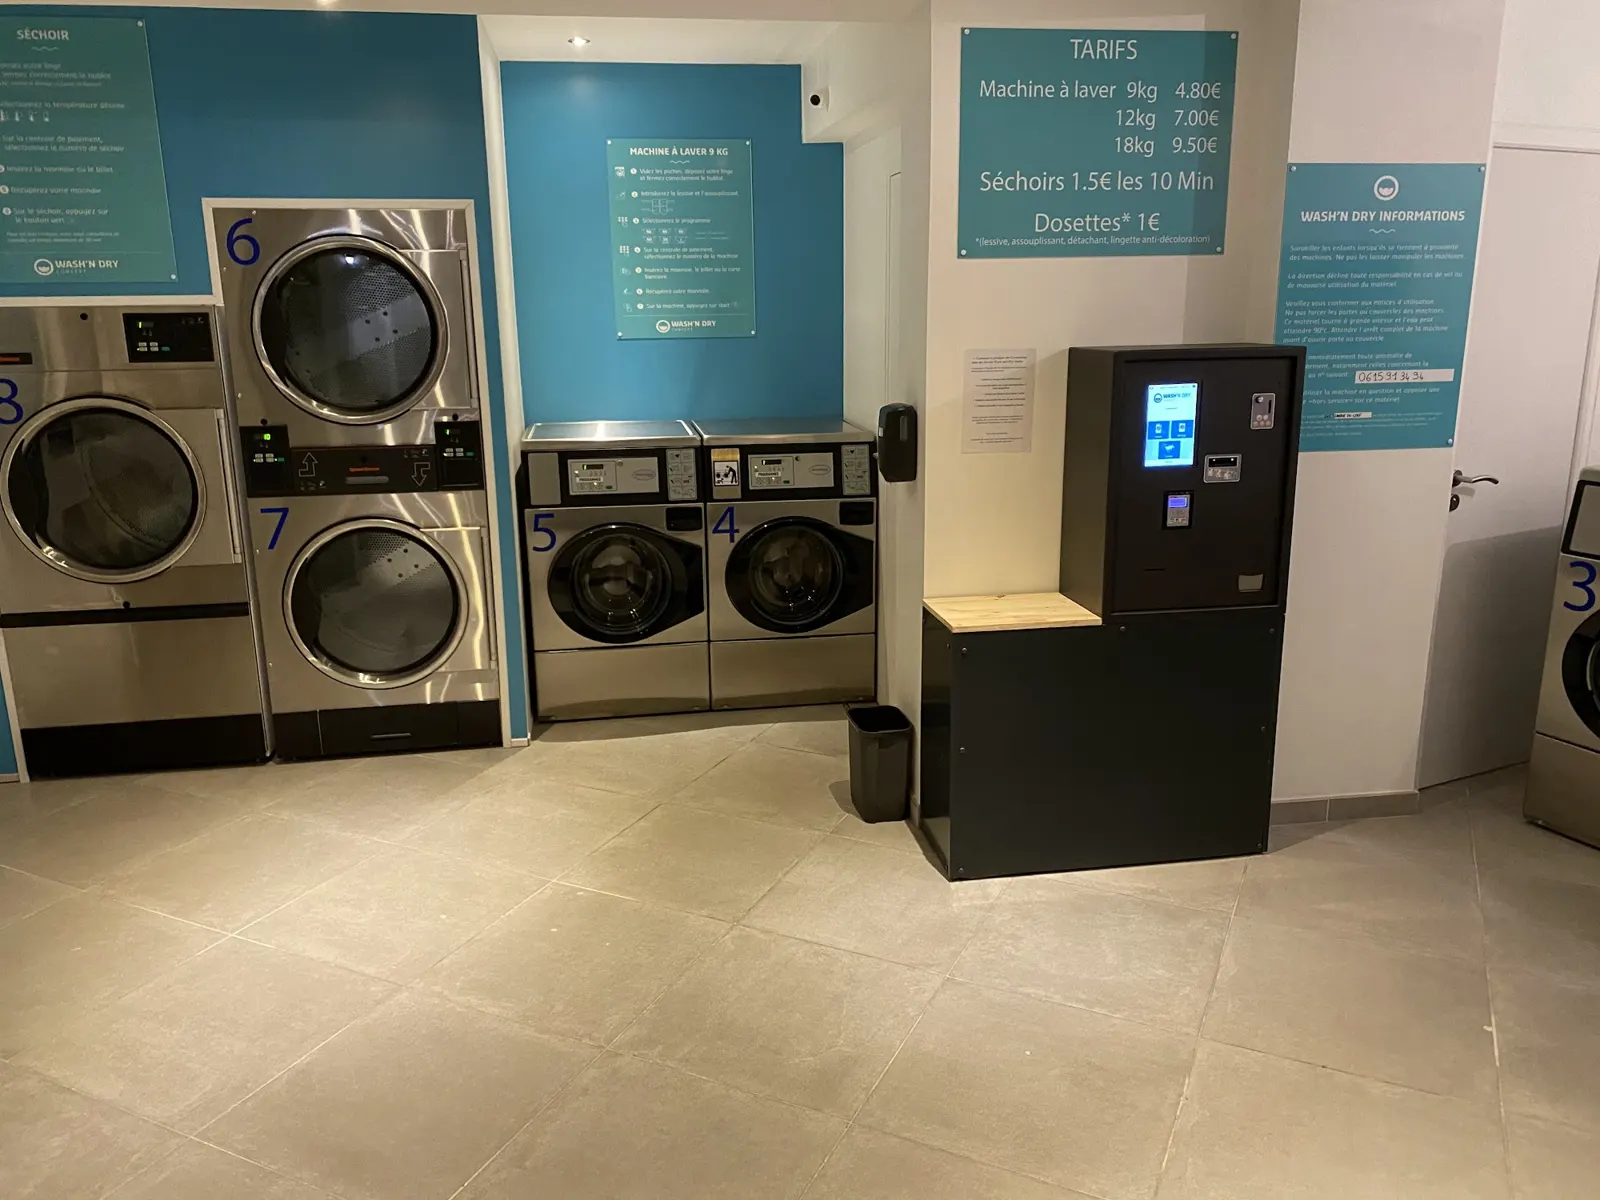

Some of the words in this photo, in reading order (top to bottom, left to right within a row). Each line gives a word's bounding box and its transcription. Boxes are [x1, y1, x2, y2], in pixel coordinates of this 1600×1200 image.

[16, 27, 70, 41] SÉCHOIR
[1070, 39, 1138, 60] TARIFS
[979, 79, 1055, 98] Machine
[1060, 81, 1070, 98] à
[1075, 80, 1116, 99] laver
[1126, 81, 1158, 102] 9kg
[1175, 82, 1222, 99] 4.80€
[1115, 109, 1156, 130] 12kg
[1173, 109, 1220, 126] 7.00€
[629, 147, 670, 156] MACHINE
[671, 145, 678, 156] À
[679, 147, 707, 156] LAVER
[708, 147, 714, 156] 9
[716, 147, 729, 156] KG
[1114, 136, 1155, 157] 18kg
[1172, 137, 1218, 154] 9.50€
[979, 171, 1065, 191] Séchoirs
[1072, 172, 1112, 191] 1.5€
[1117, 171, 1143, 191] les
[1151, 172, 1172, 191] 10
[1178, 172, 1214, 190] Min
[1138, 212, 1160, 231] 1€
[1300, 210, 1349, 222] WASH'N
[1352, 210, 1376, 222] DRY
[1379, 210, 1466, 222] INFORMATIONS
[225, 217, 261, 266] 6
[1011, 236, 1066, 246] assouplissant,
[1067, 235, 1109, 245] détachant,
[1110, 235, 1141, 246] lingette
[1142, 235, 1211, 245] anti-décoloration)
[55, 260, 96, 269] WASH'N
[99, 260, 119, 269] DRY
[0, 378, 19, 425] 8
[260, 507, 290, 550] 7
[532, 513, 557, 552] 5
[711, 506, 740, 543] 4
[1563, 560, 1597, 612] 3
